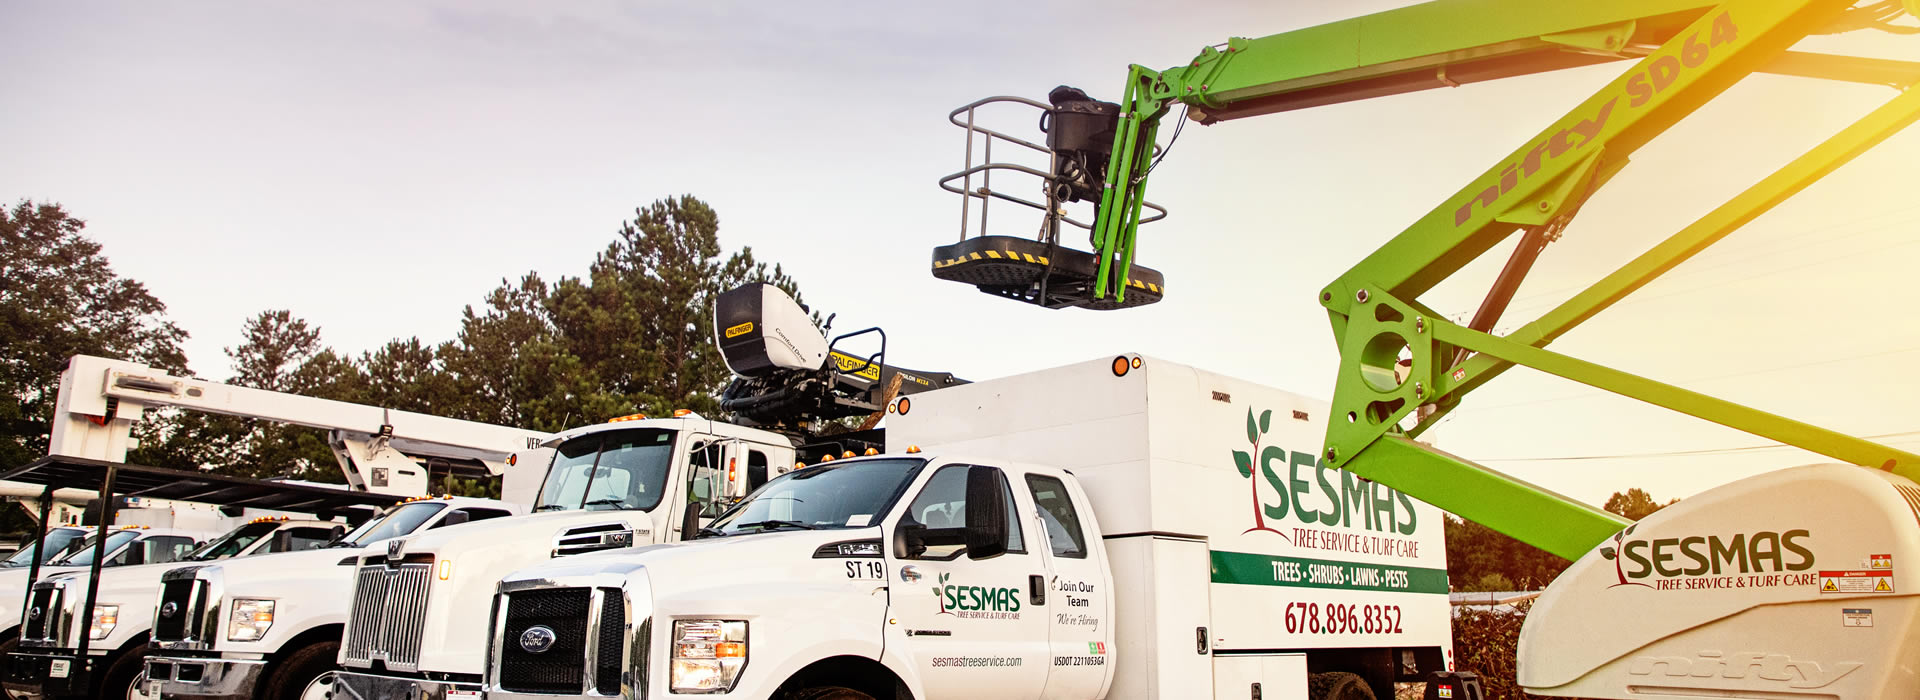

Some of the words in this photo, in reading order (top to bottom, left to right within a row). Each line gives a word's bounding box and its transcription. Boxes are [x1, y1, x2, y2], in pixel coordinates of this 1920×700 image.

[1455, 96, 1619, 227] nifty
[1625, 10, 1738, 108] SD64
[727, 323, 752, 337] PALFINGER
[775, 327, 796, 351] Comfort
[794, 347, 807, 363] Drive
[526, 436, 544, 449] VER
[1261, 445, 1417, 536] SESMAS
[1292, 527, 1318, 549] TREE
[1320, 530, 1360, 554] SERVICE
[1362, 535, 1370, 553] &
[1371, 536, 1395, 556] TURF
[1396, 539, 1419, 559] CARE
[1623, 529, 1815, 579] SESMAS
[845, 560, 862, 579] ST
[866, 560, 883, 579] 19
[1272, 561, 1301, 583] TREES
[1308, 563, 1344, 585] SHRUBS
[1351, 567, 1379, 587] LAWNS
[1385, 569, 1408, 588] PESTS
[1059, 580, 1077, 591] Join
[1079, 581, 1094, 592] Our
[1655, 578, 1683, 591] TREE
[1685, 576, 1733, 590] SERVICE
[1736, 576, 1746, 588] &
[1749, 574, 1781, 588] TURF
[1783, 573, 1817, 586] CARE
[944, 584, 1021, 612] SESMAS
[1066, 595, 1089, 607] Team
[969, 611, 990, 619] SERVICE
[1057, 613, 1077, 625] We're
[1078, 614, 1098, 632] Hiring
[1285, 602, 1402, 634] 678.896.8352
[525, 631, 543, 646] Ford
[932, 656, 1022, 668] sesmastreeservice.com
[1054, 656, 1073, 666] USDOT
[1629, 651, 1863, 689] nifty
